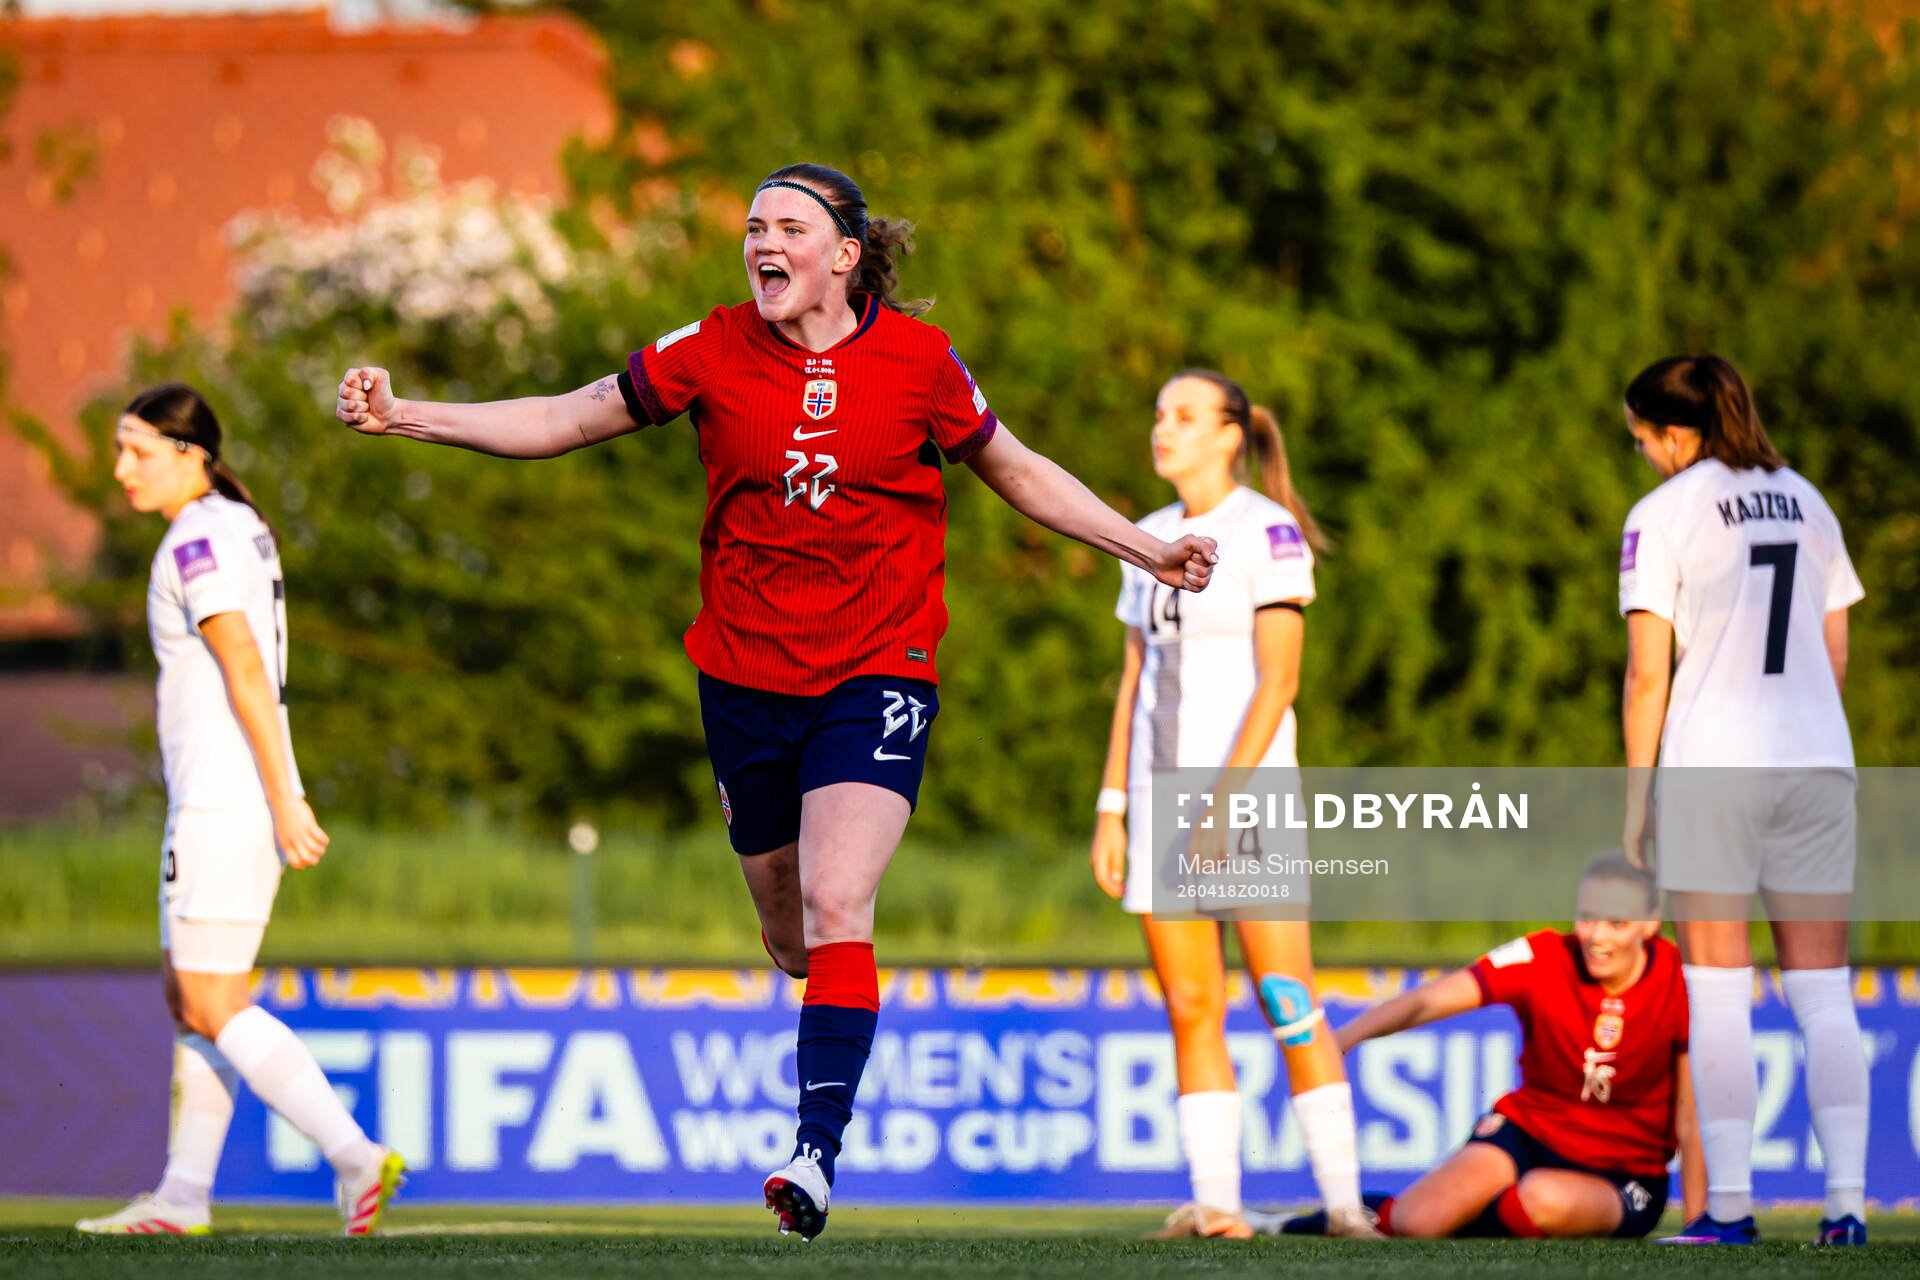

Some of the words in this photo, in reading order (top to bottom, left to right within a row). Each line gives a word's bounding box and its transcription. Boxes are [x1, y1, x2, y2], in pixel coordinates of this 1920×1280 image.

[784, 450, 839, 511] 22
[1750, 542, 1798, 675] 7
[883, 690, 928, 742] 22
[672, 1109, 940, 1173] WOLD
[947, 1109, 1094, 1173] CUP
